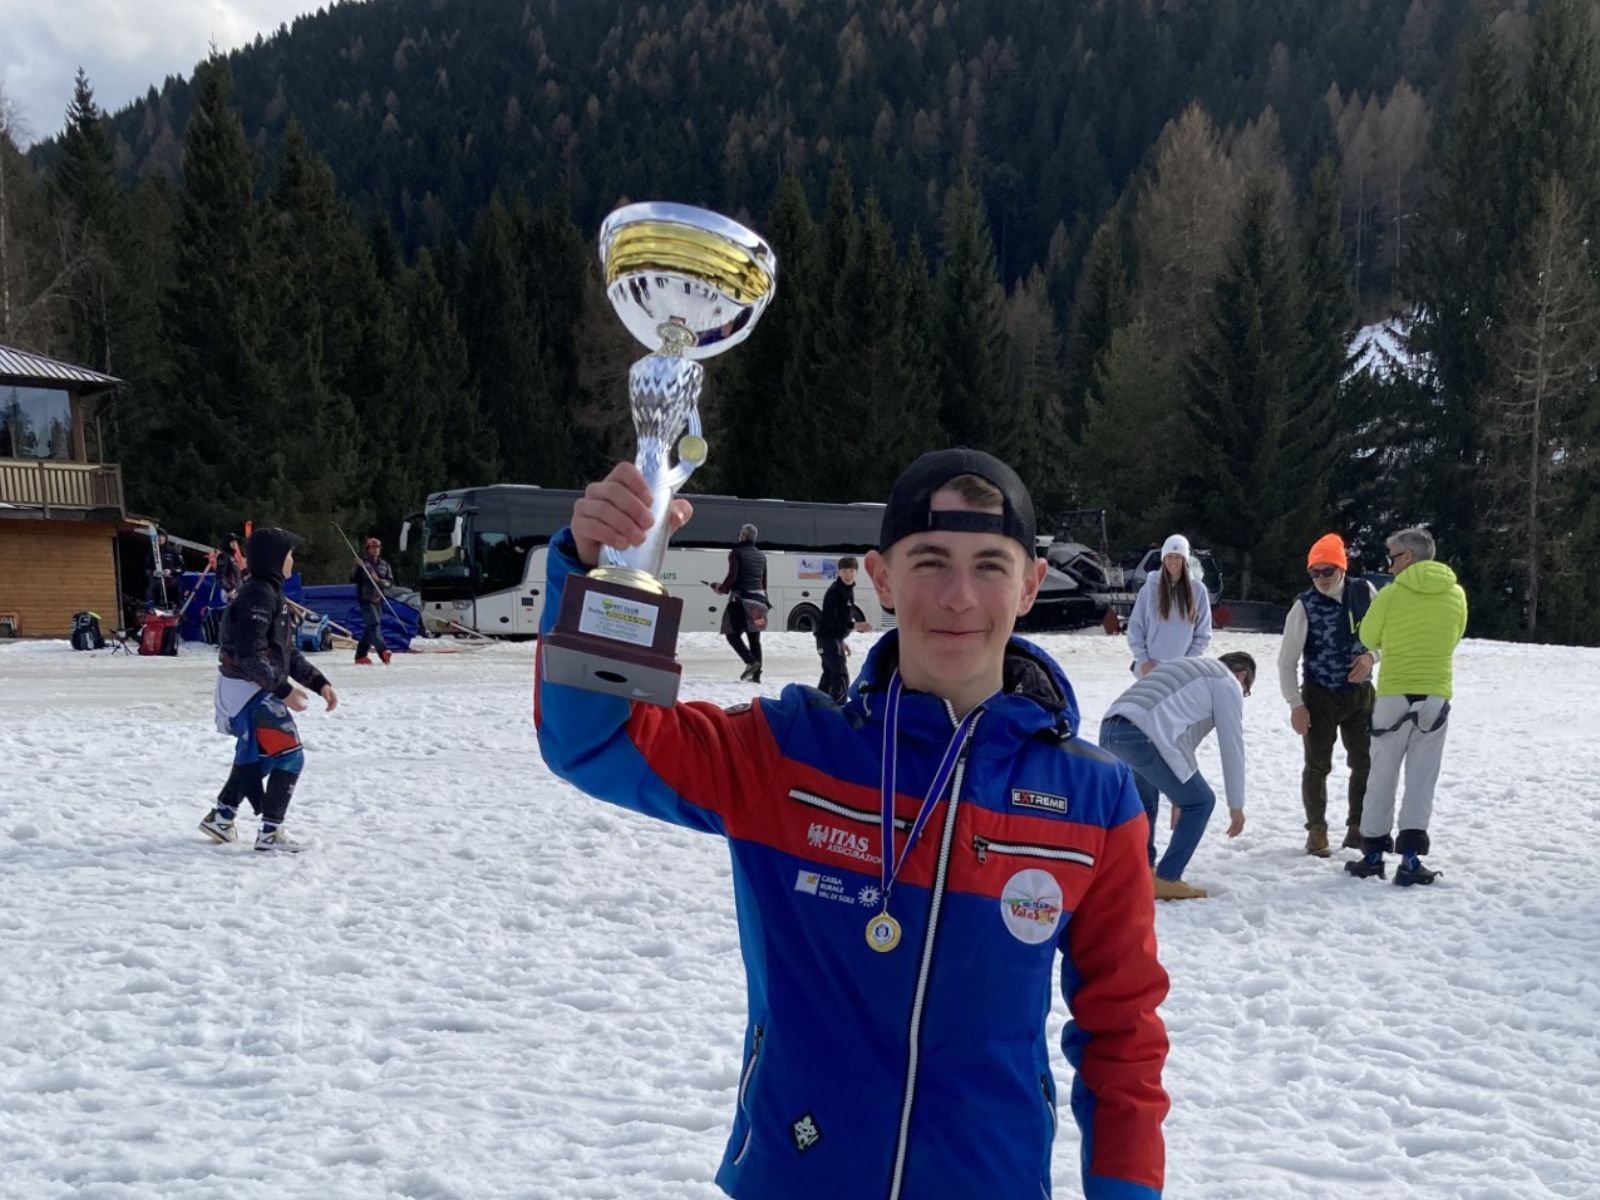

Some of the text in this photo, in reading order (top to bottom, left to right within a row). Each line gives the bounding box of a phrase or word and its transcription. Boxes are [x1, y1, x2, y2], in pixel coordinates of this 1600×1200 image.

[1014, 792, 1065, 809] EXTREME
[829, 828, 869, 852] ITAS
[827, 844, 883, 864] ASSICURAZIO
[838, 895, 855, 904] SOLE
